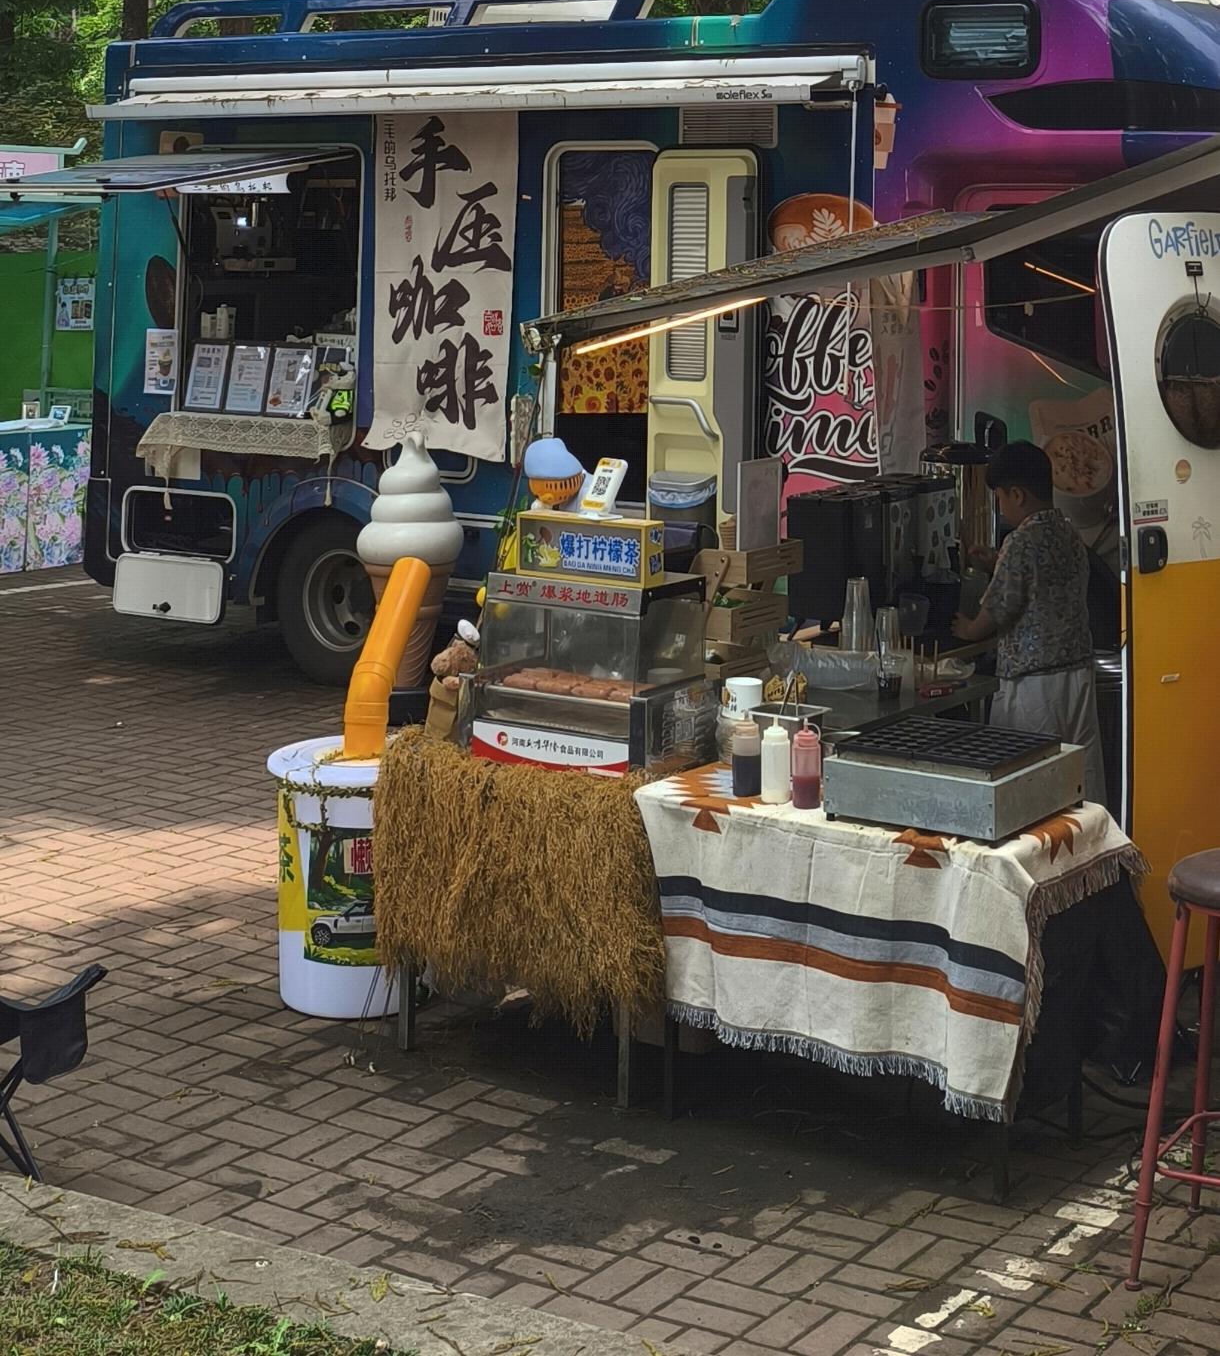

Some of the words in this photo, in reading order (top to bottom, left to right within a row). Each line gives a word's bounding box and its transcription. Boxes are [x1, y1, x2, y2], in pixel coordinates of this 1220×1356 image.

[560, 533, 641, 566] 爆打柠檬茶
[563, 560, 576, 568] BAO
[603, 564, 622, 573] MENG
[623, 566, 635, 574] CHA
[541, 584, 629, 608] 爆浆地道肠
